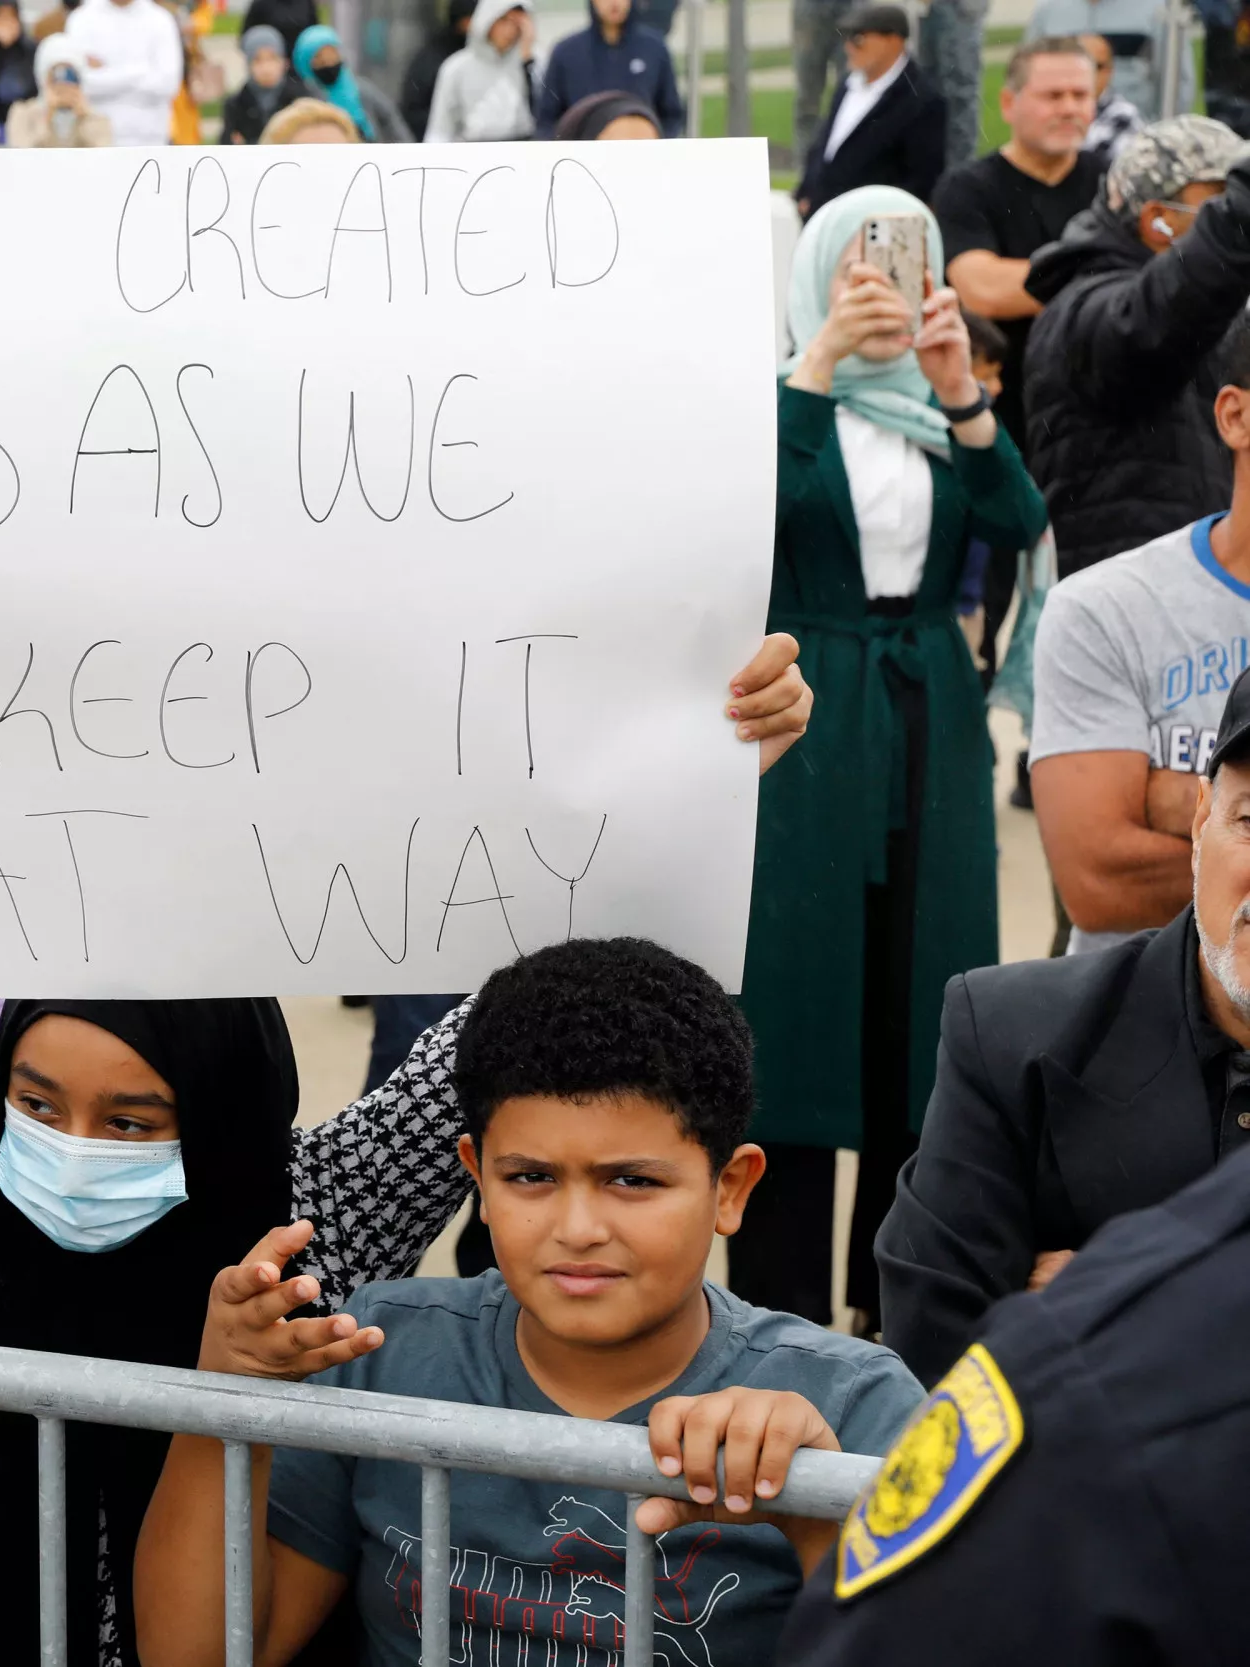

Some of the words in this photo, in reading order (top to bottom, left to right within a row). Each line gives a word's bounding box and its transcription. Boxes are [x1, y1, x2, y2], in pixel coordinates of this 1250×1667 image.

[116, 156, 619, 313] CREATED
[70, 363, 222, 528] AS
[298, 368, 514, 523] WE
[457, 635, 578, 779] IT
[252, 813, 607, 966] WAY
